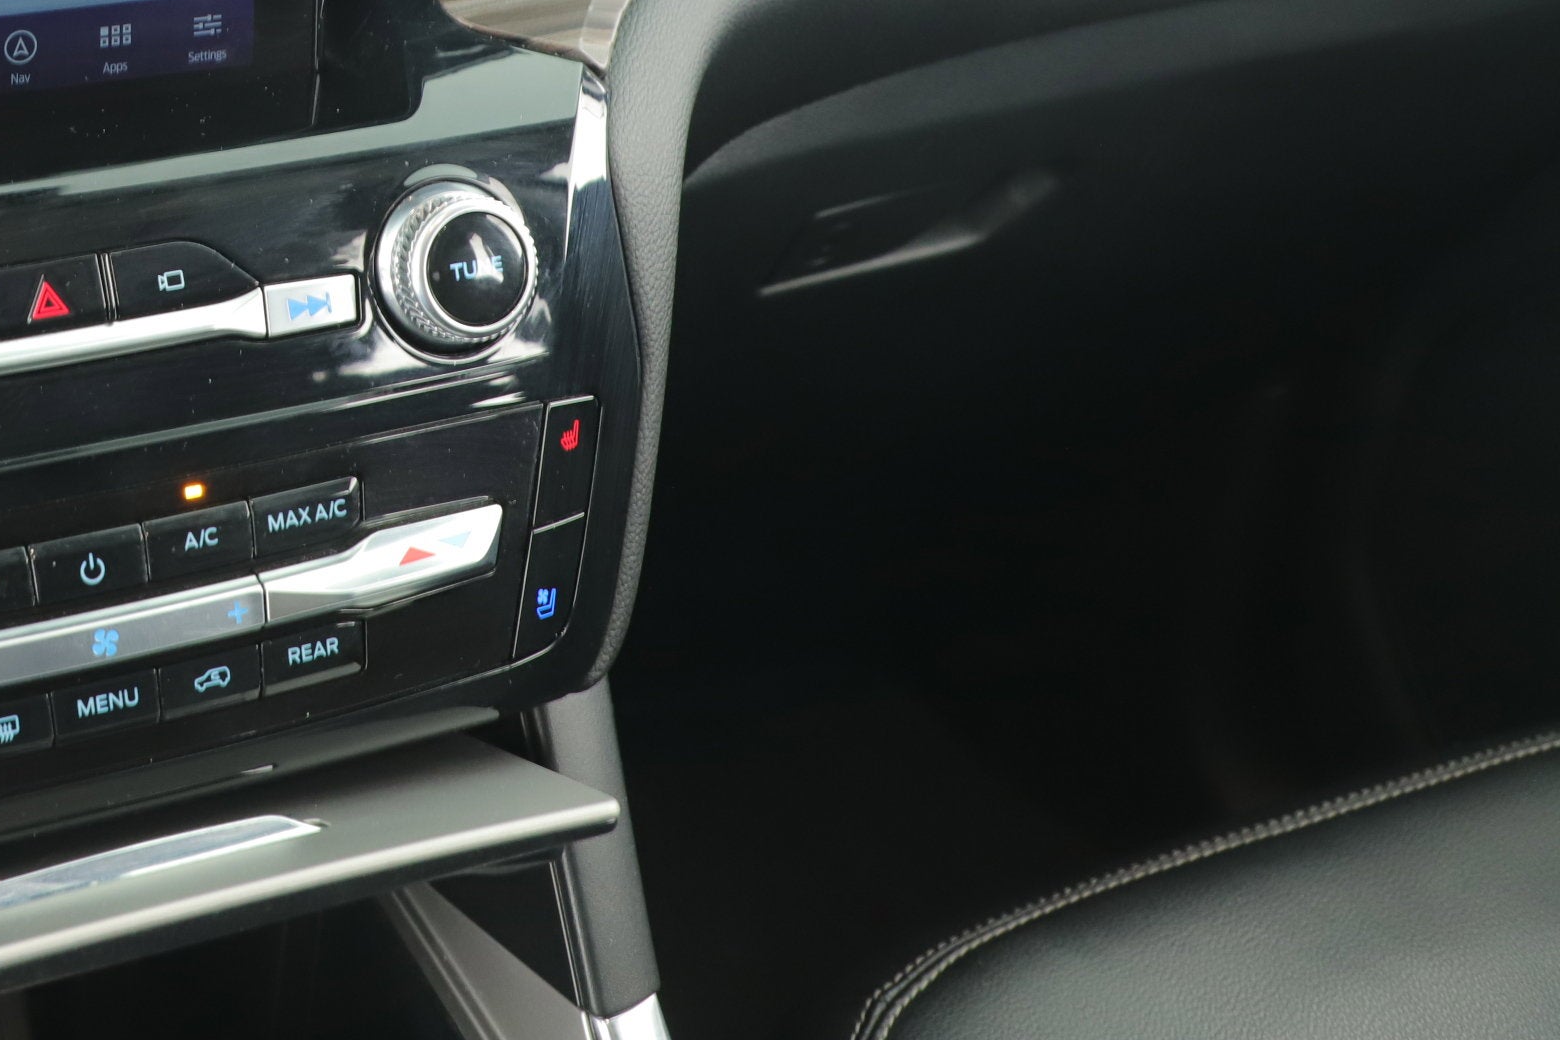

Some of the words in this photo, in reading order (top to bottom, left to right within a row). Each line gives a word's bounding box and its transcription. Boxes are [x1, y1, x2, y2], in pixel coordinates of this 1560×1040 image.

[103, 61, 128, 75] Apps
[188, 48, 227, 65] Settings
[11, 73, 31, 85] Nav
[450, 255, 503, 283] TUE
[267, 505, 312, 533] MAX
[315, 499, 348, 522] A/C
[184, 526, 219, 552] A/C
[287, 637, 339, 666] REAR
[77, 686, 140, 719] MENU
